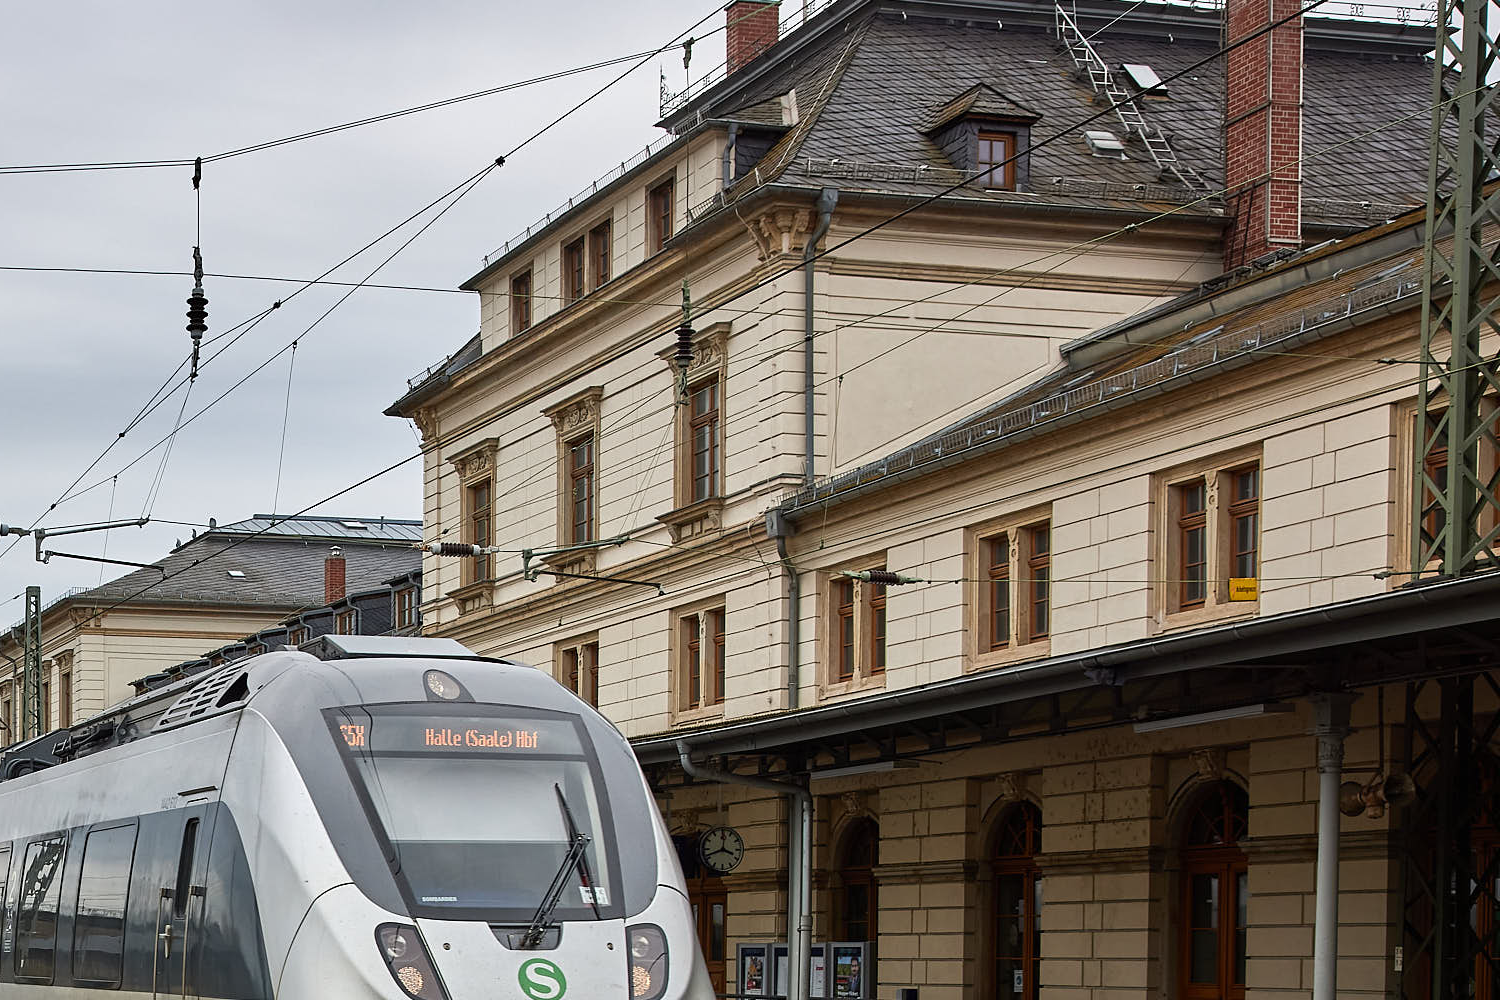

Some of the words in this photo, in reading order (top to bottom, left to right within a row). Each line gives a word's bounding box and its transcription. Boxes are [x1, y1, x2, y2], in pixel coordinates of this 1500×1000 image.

[339, 724, 365, 747] S5X
[425, 728, 462, 747] Halle
[465, 729, 512, 748] (Saale)
[516, 730, 539, 748] Hbf
